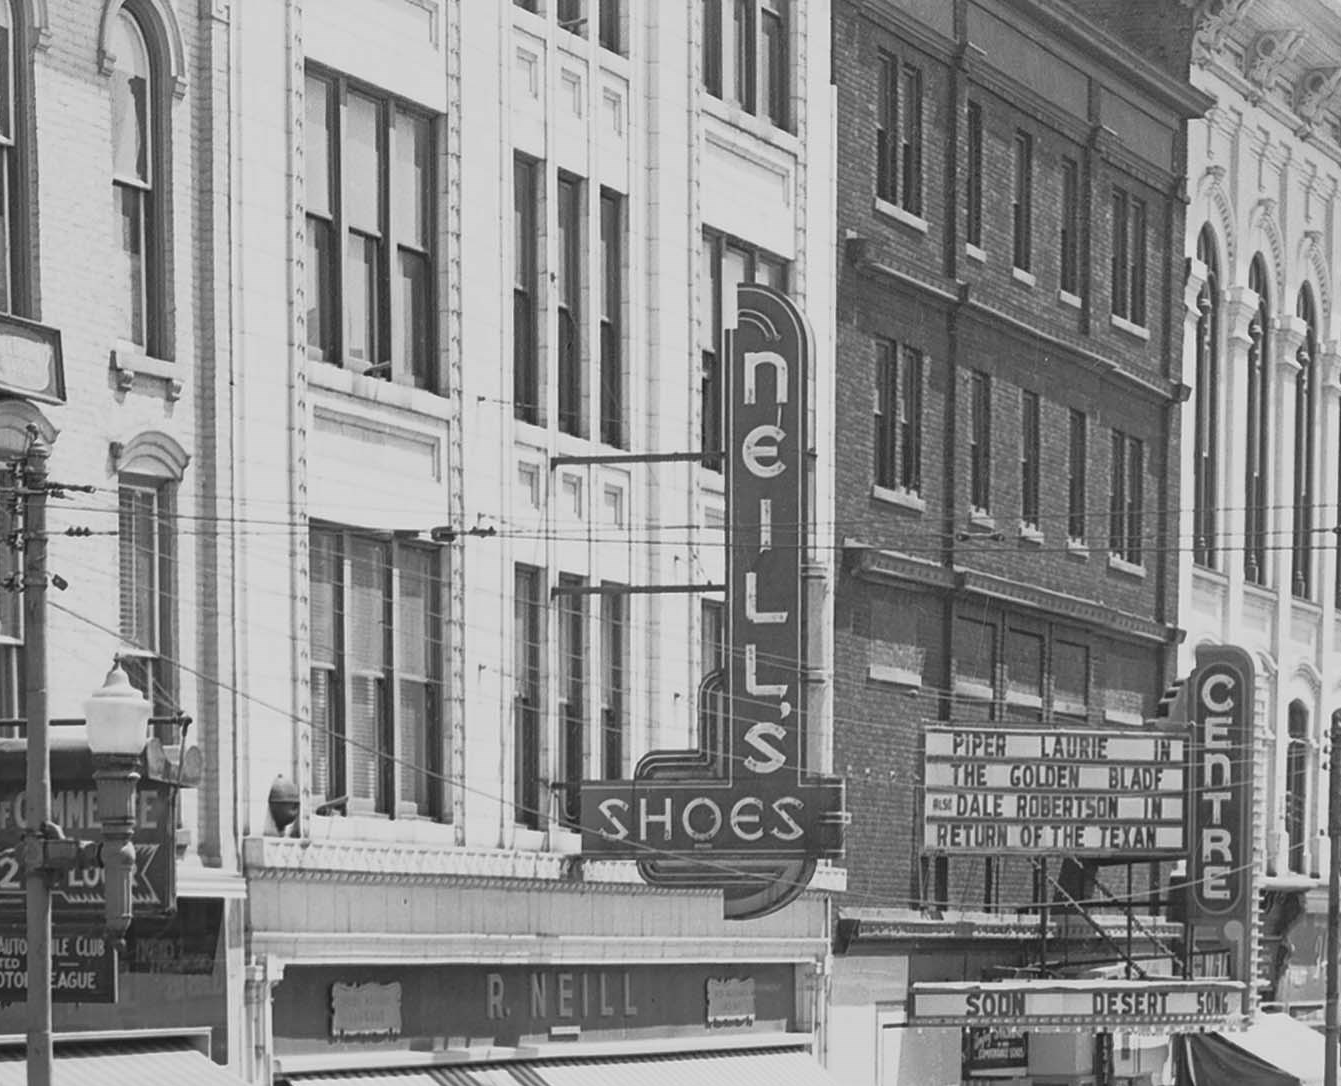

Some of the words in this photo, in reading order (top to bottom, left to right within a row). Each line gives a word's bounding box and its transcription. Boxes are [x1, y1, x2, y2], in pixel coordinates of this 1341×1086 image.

[952, 734, 1006, 757] PIPER
[1040, 736, 1109, 759] LAURIE
[1154, 739, 1172, 762] IN
[950, 764, 987, 787] THE
[1010, 765, 1080, 788] GOLDEN
[1200, 674, 1234, 901] CENTRE
[597, 796, 806, 842] SHOES
[932, 797, 953, 812] ALSO
[956, 794, 1004, 817] DALE
[1016, 795, 1119, 819] ROBERTSON
[1143, 797, 1160, 819] IN
[937, 824, 1007, 848] RETURN
[1020, 826, 1043, 848] OF
[1050, 826, 1085, 848] THE
[1100, 826, 1157, 849] TEXAN
[75, 935, 106, 958] CLUB
[50, 970, 97, 990] EAGUE
[486, 972, 511, 1019] R.
[529, 972, 637, 1018] NEILL
[965, 991, 1026, 1017] SOON
[1092, 991, 1169, 1016] DESERT
[1196, 991, 1229, 1015] SONG
